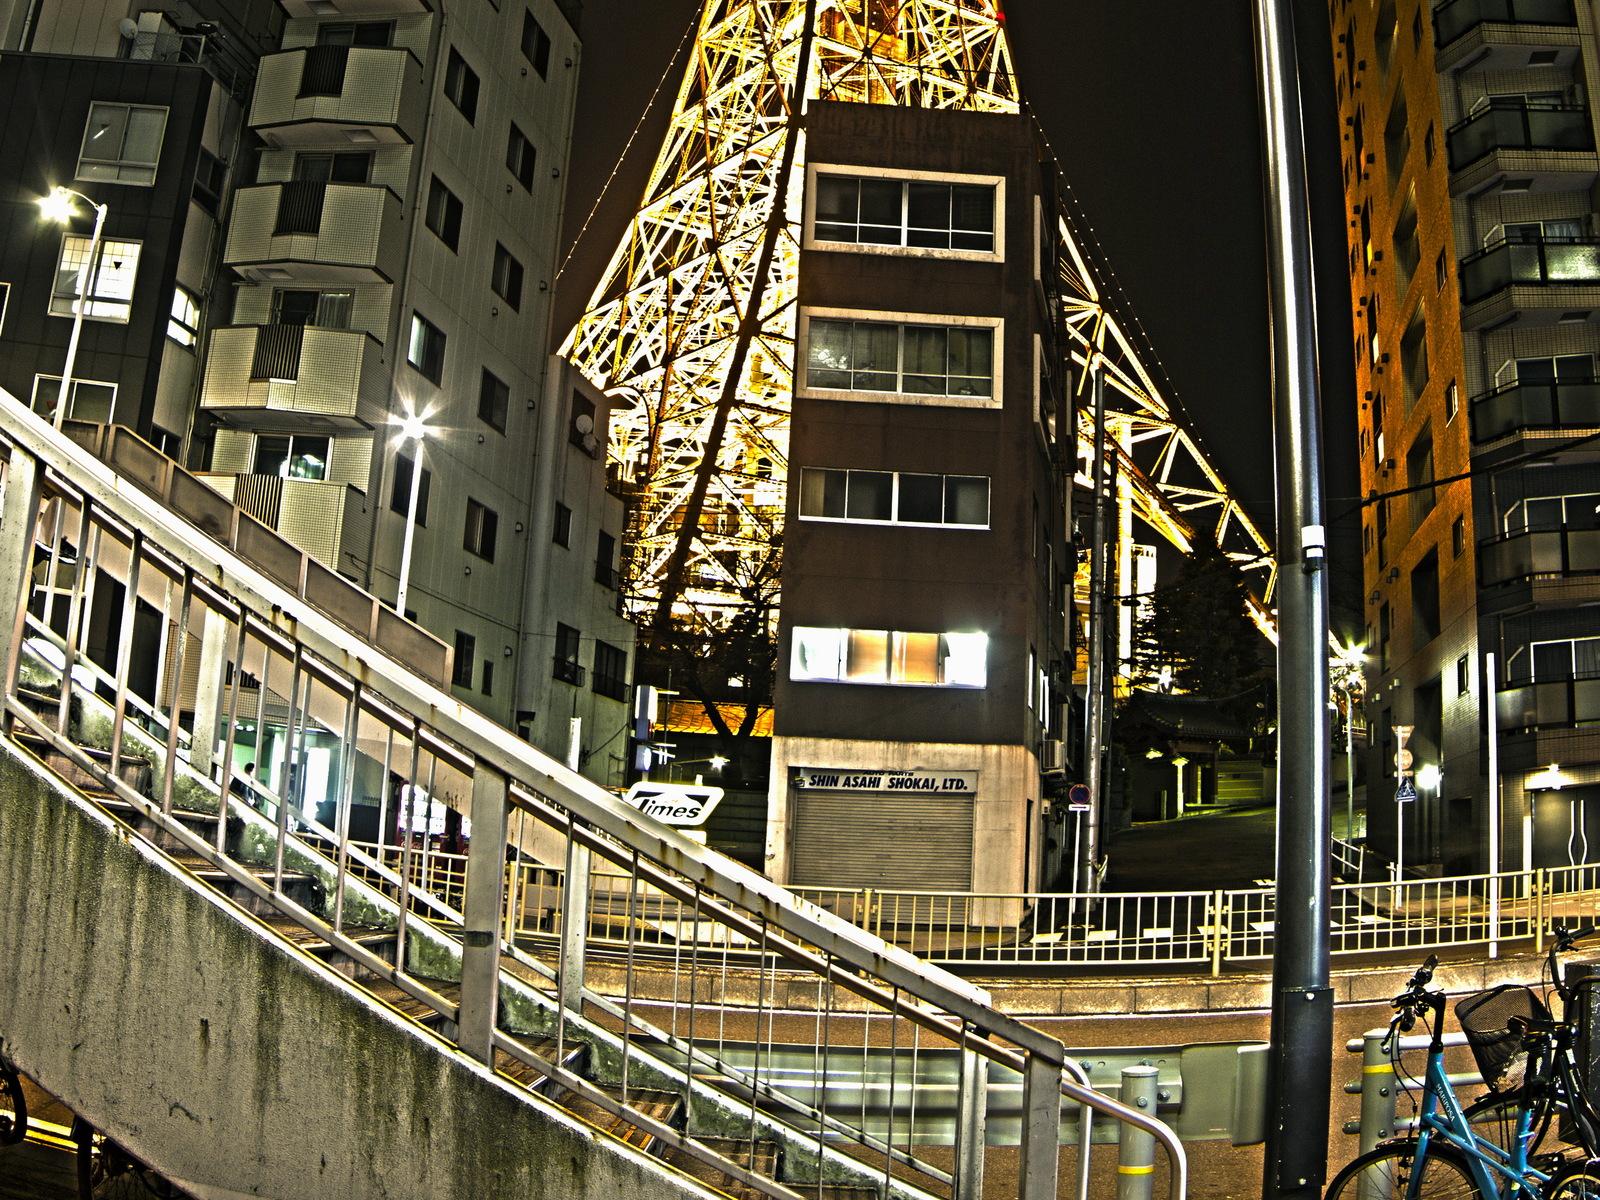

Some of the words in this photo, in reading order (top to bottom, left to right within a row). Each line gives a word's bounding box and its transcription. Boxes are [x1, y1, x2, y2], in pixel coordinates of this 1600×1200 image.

[809, 774, 839, 787] SHIN
[842, 776, 880, 789] ASAHI
[888, 777, 939, 792] SHOKAI,
[942, 778, 968, 791] LTD.
[1436, 1084, 1455, 1122] MARIPOSA
